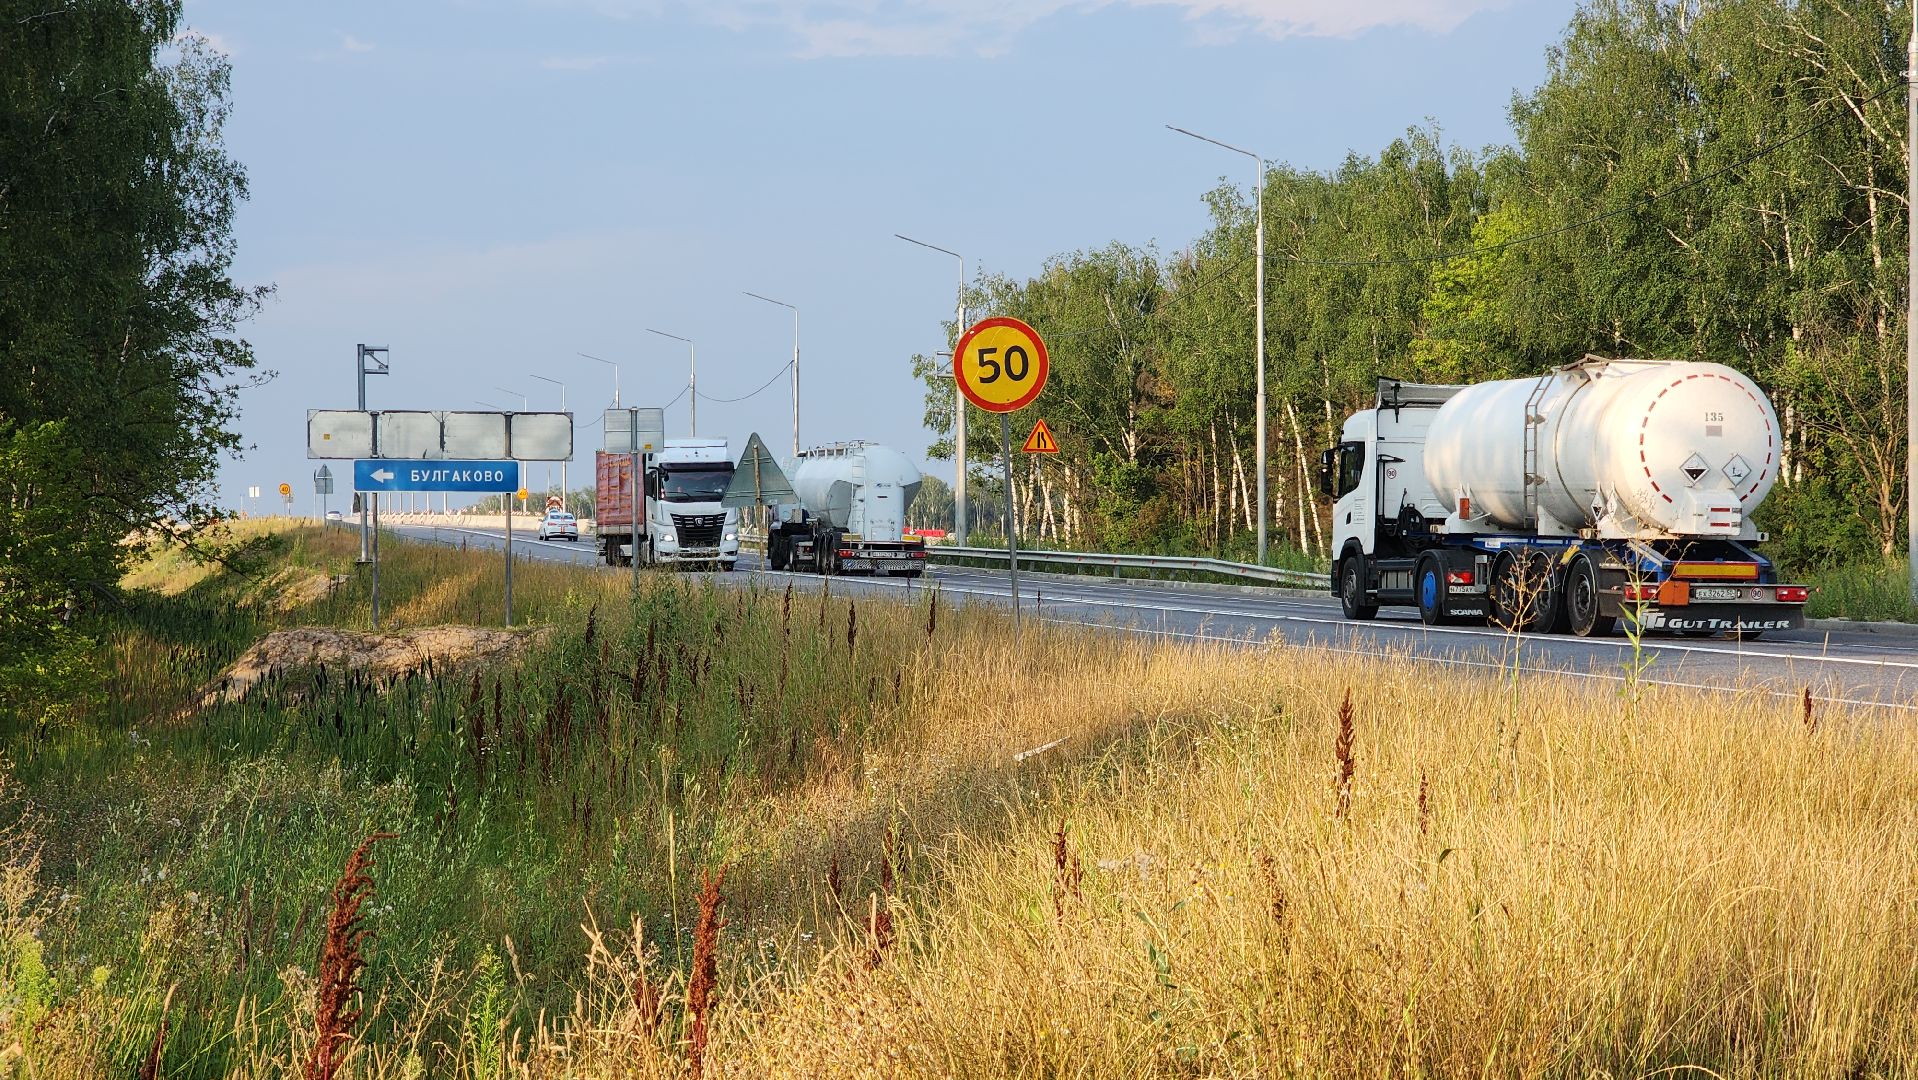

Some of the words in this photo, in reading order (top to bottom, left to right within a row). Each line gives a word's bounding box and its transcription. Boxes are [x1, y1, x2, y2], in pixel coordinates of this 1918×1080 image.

[978, 345, 1029, 384] 50
[1704, 411, 1724, 422] 135
[410, 469, 504, 482] БУЛГАКОВО
